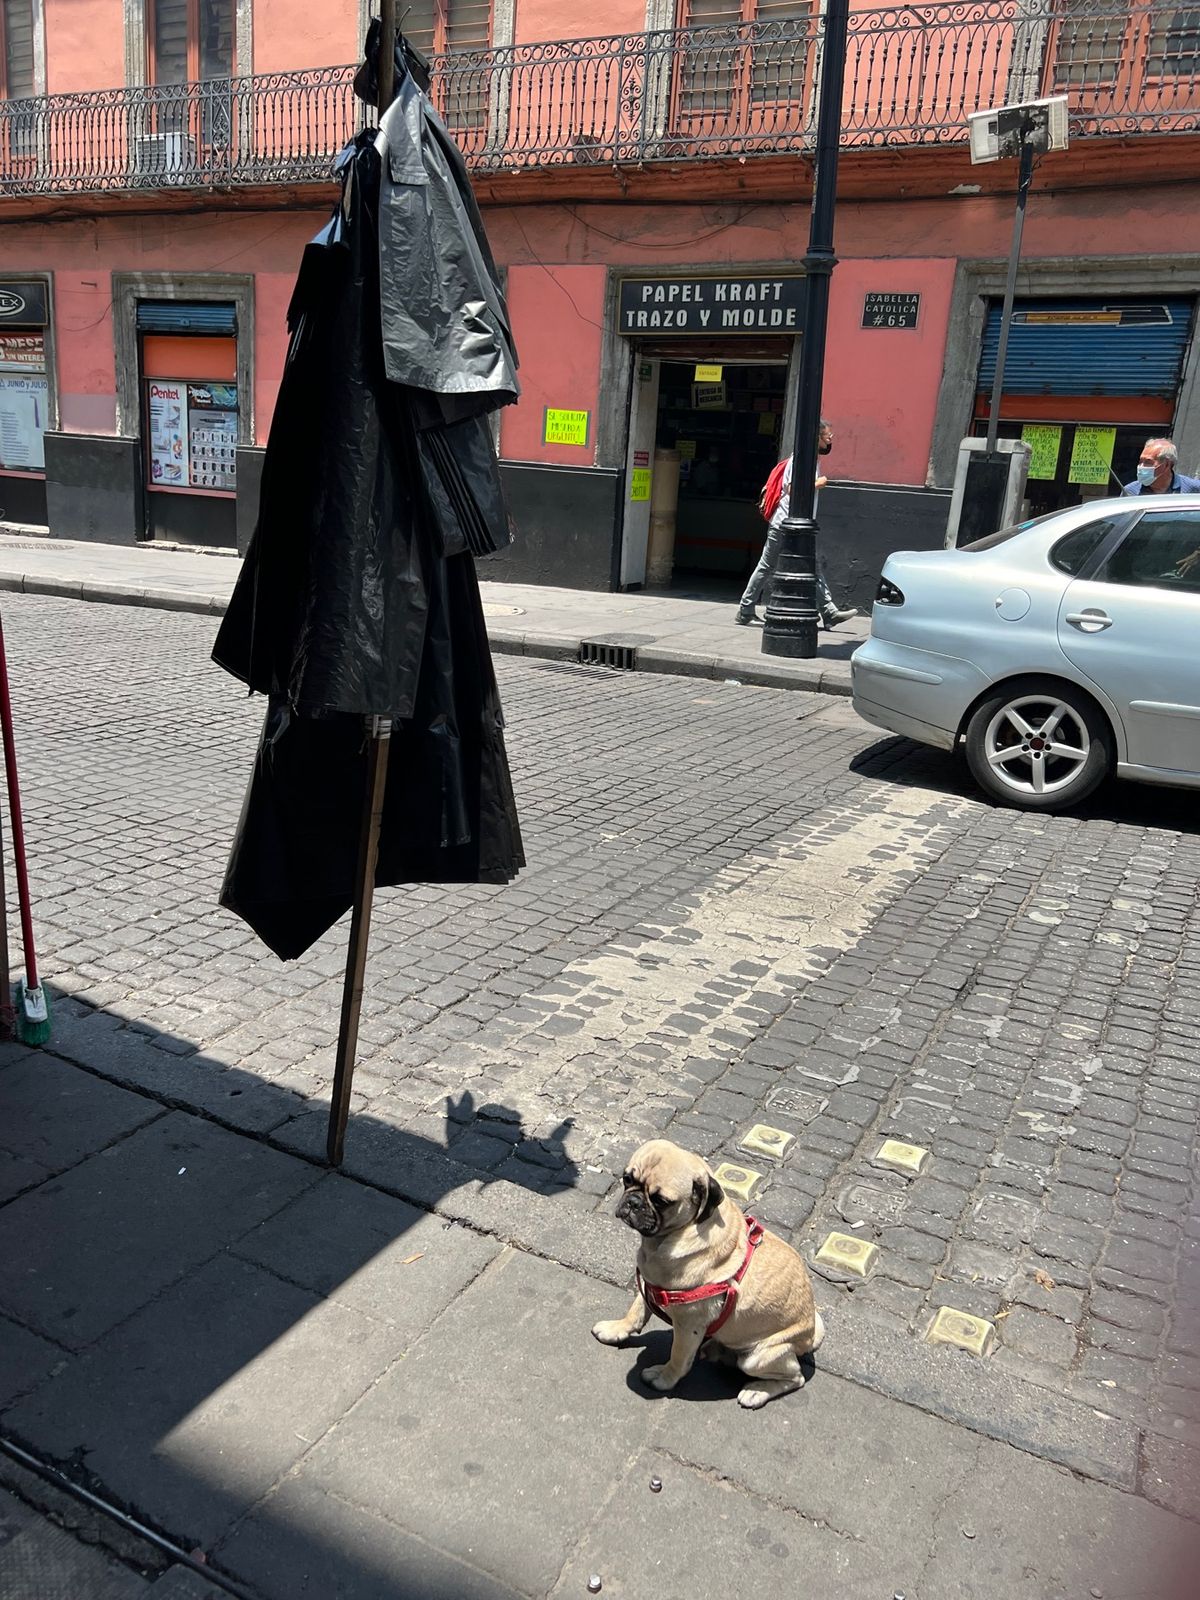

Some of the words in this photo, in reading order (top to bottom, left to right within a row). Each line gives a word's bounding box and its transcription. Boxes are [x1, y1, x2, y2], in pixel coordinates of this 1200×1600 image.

[642, 285, 704, 302] PAPEL
[715, 282, 784, 301] KRAFT
[865, 294, 902, 303] ISABEL
[905, 295, 918, 303] LA
[865, 304, 916, 313] CATOLICA
[626, 310, 688, 327] TRAZO
[699, 309, 711, 327] Y
[722, 308, 797, 327] MOLDE
[7, 379, 25, 388] JUNIO
[31, 380, 48, 389] JULIO
[151, 385, 180, 400] Pentel
